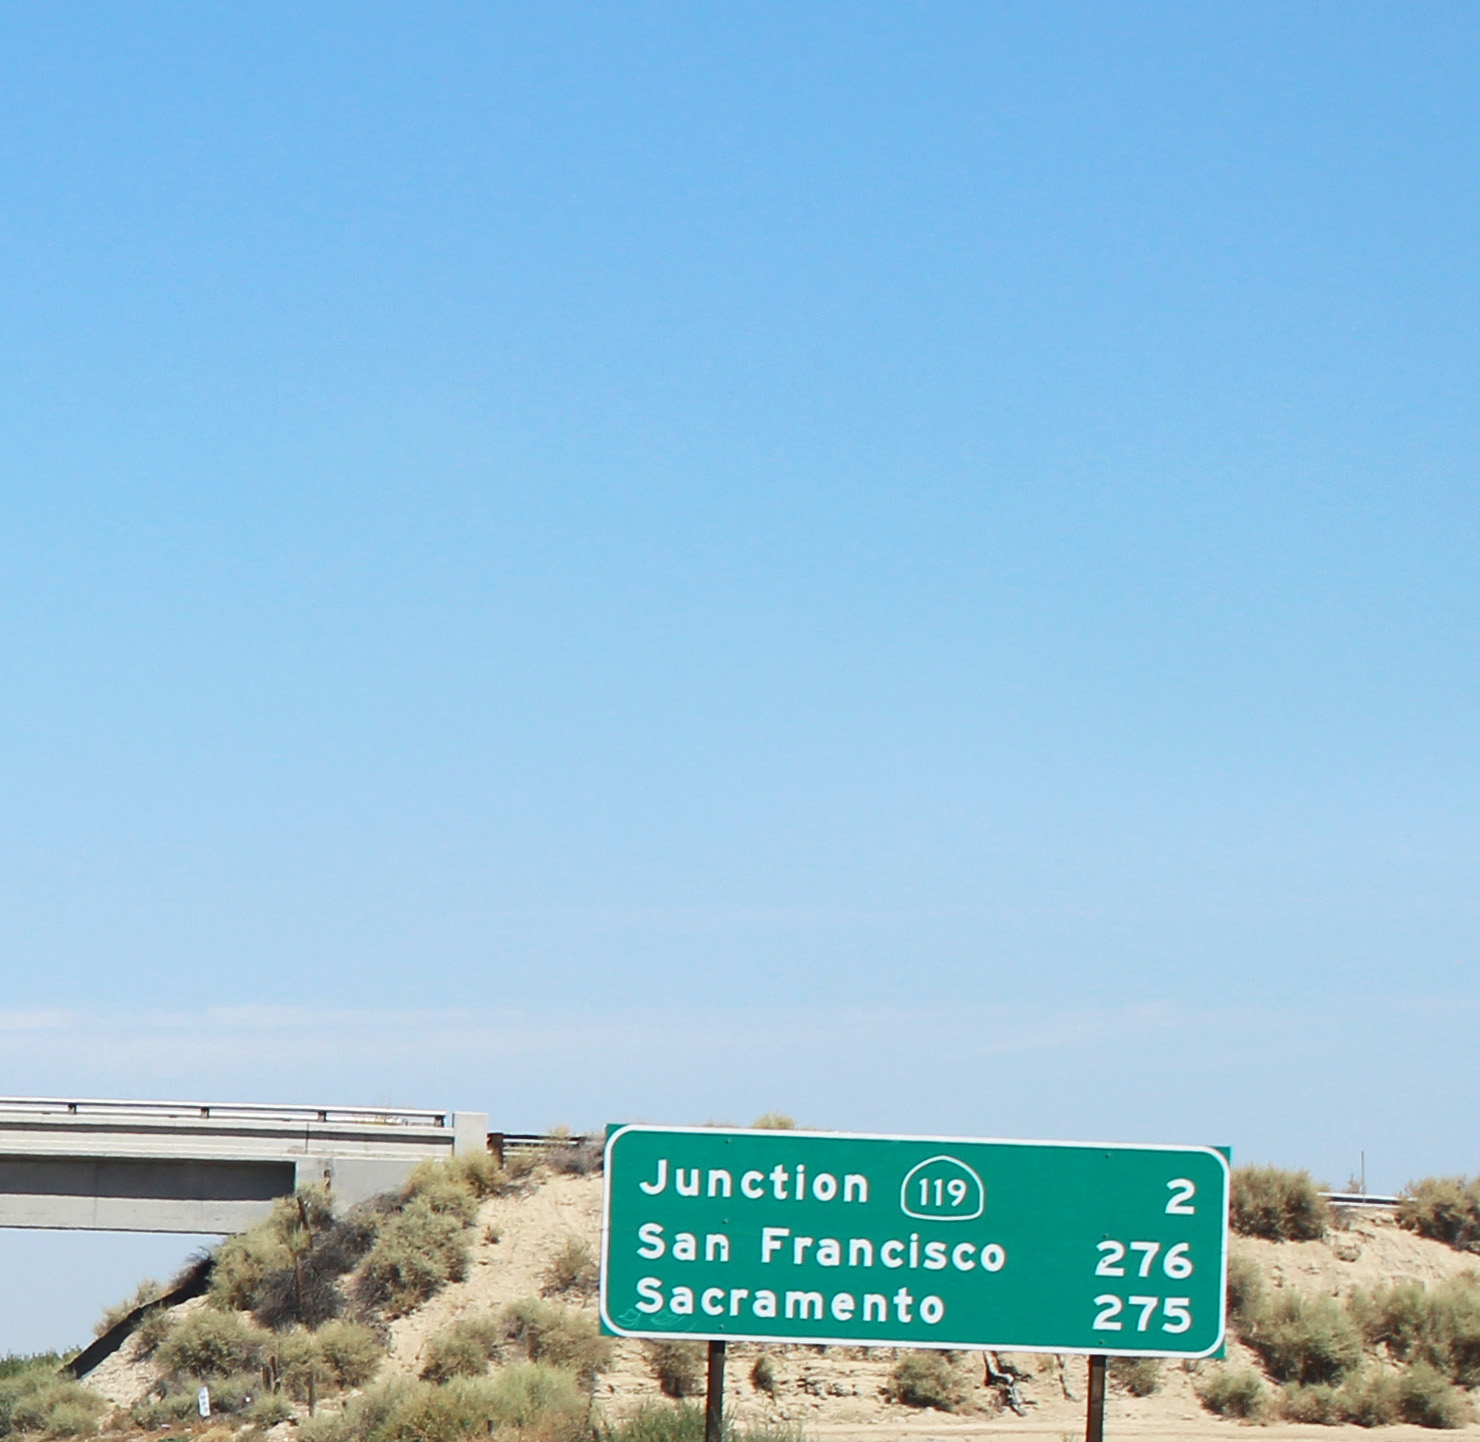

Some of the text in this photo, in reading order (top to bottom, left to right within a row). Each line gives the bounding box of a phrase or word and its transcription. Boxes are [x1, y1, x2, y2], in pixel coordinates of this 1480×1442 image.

[639, 1159, 1196, 1215] Junction 119 2
[638, 1222, 1194, 1279] San Francisco 276
[636, 1277, 1192, 1334] Sacramento 275
